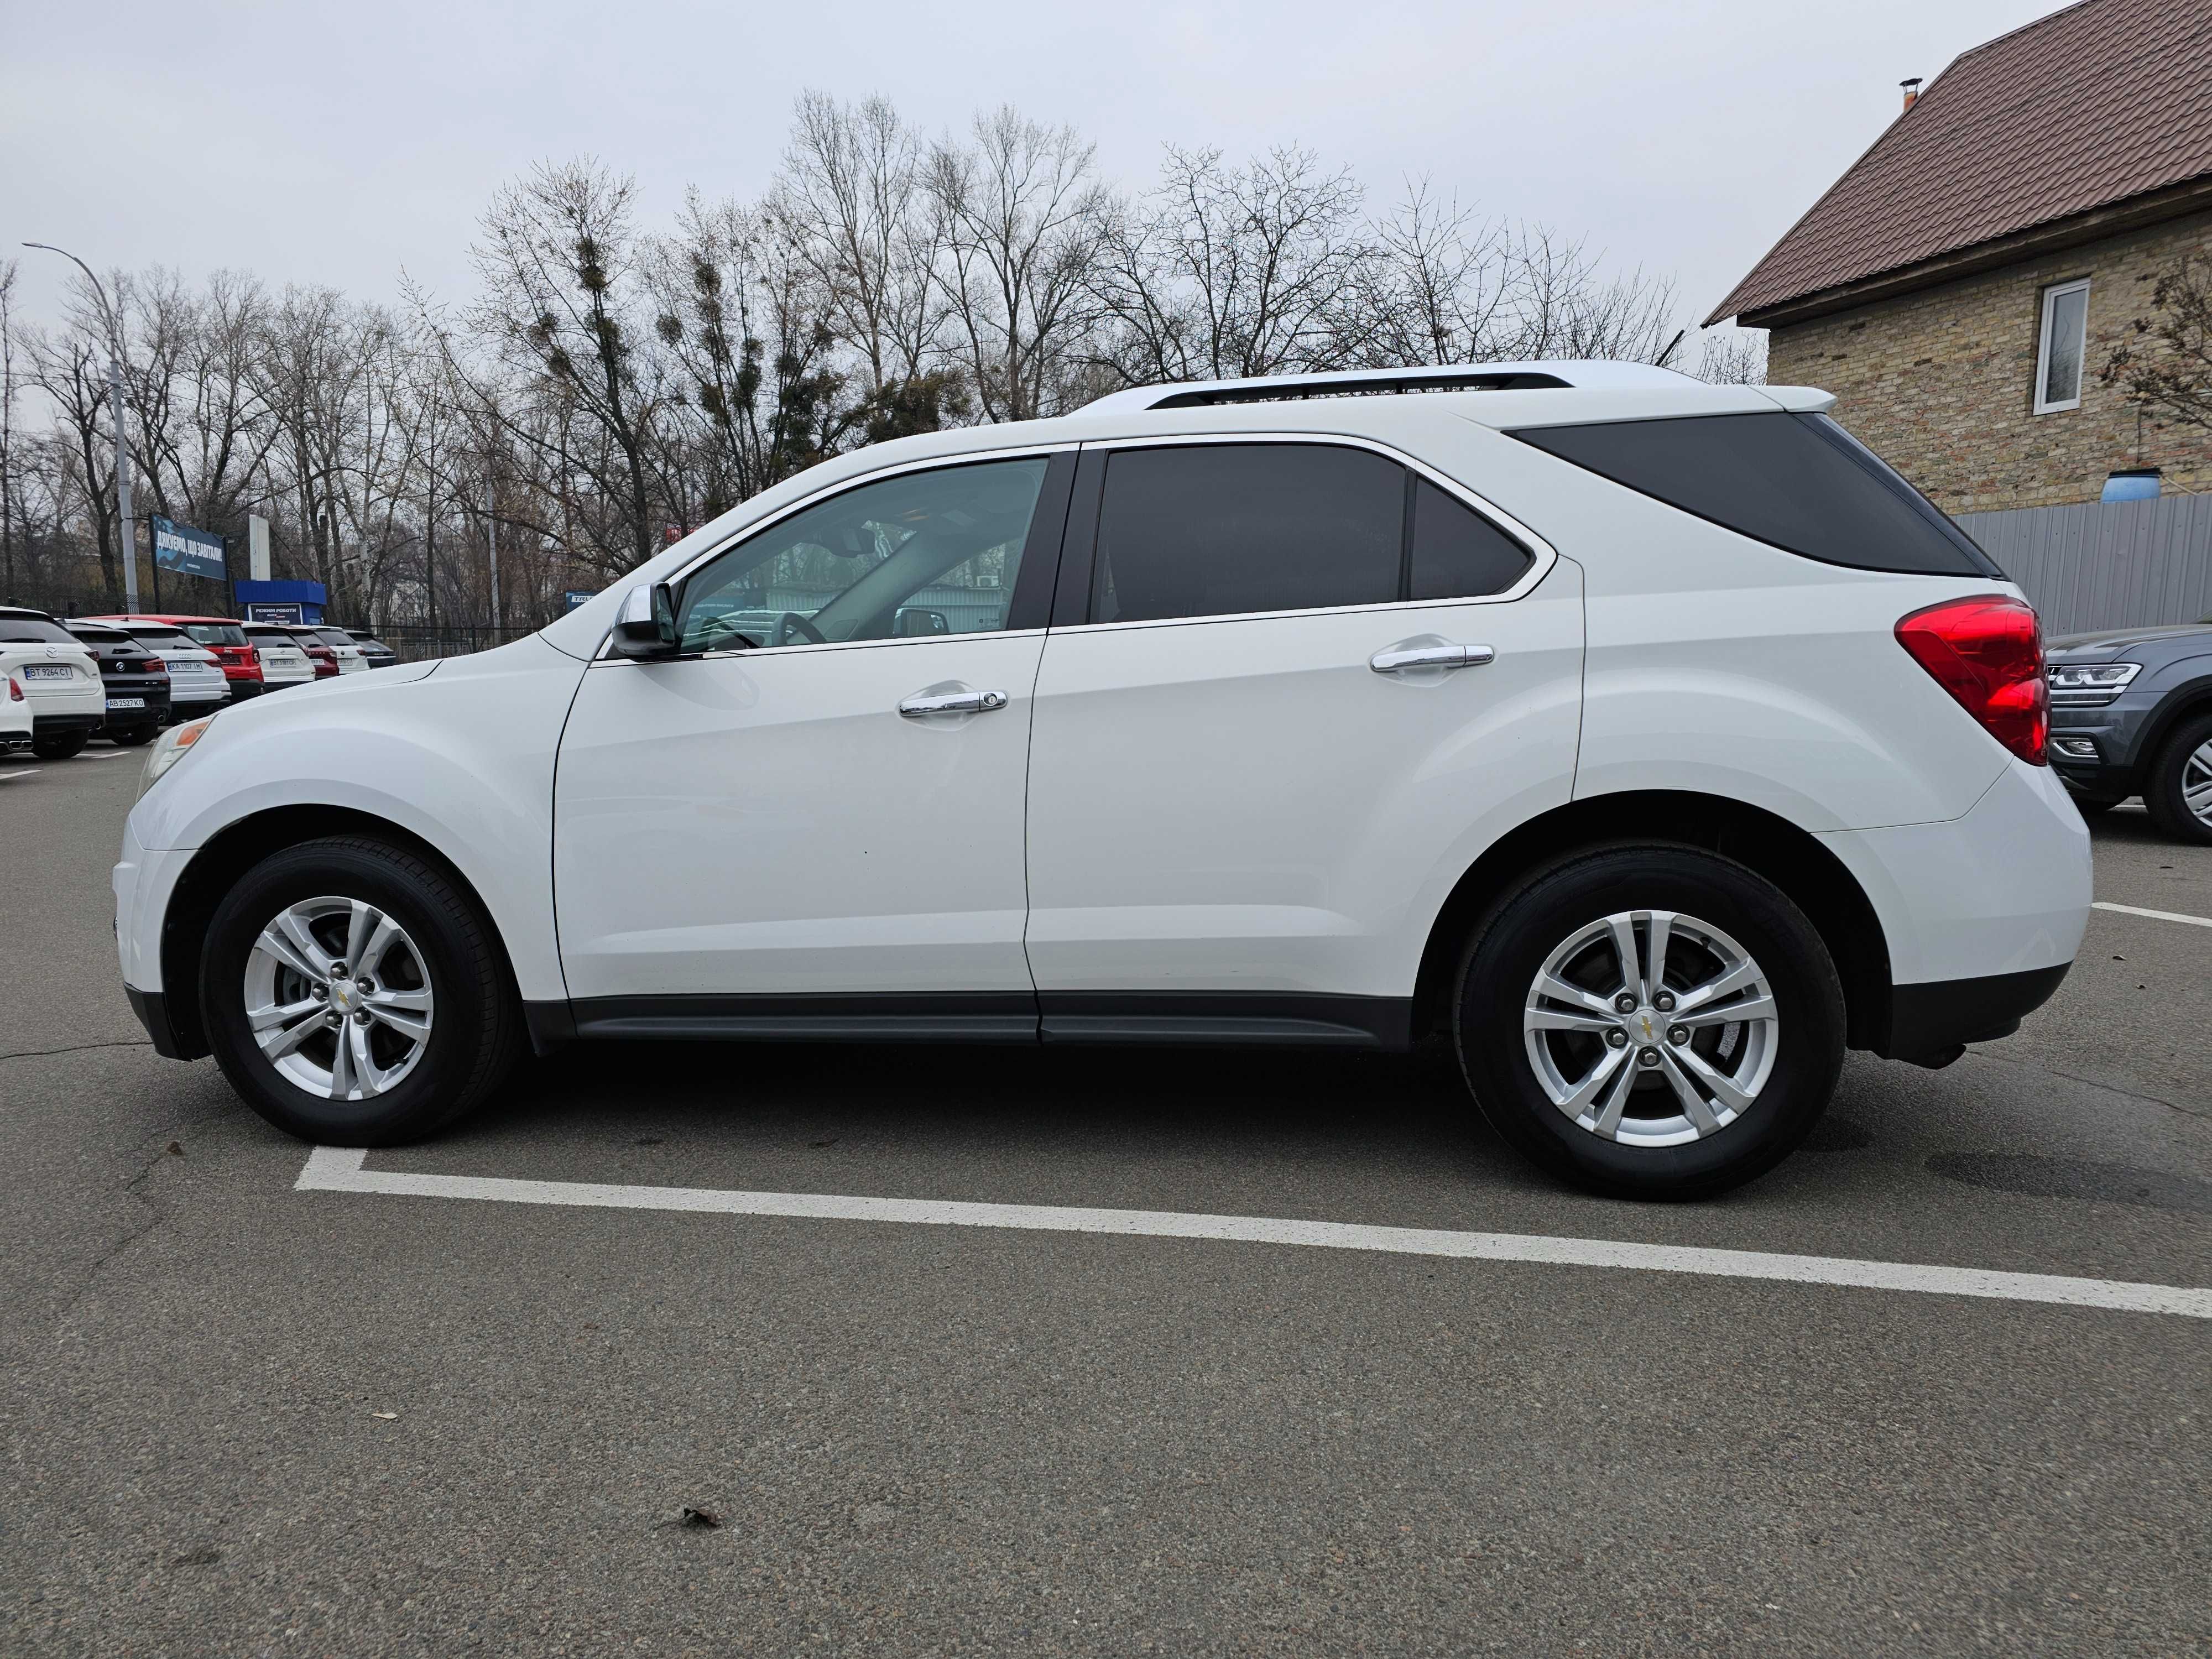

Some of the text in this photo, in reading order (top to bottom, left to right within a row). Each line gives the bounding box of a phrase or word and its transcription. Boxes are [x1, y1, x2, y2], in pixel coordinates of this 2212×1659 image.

[158, 530, 222, 562] ДЯКУЄМО, ЩО ЗАВІТАЛИ!
[30, 668, 69, 676] BT 9264 CI
